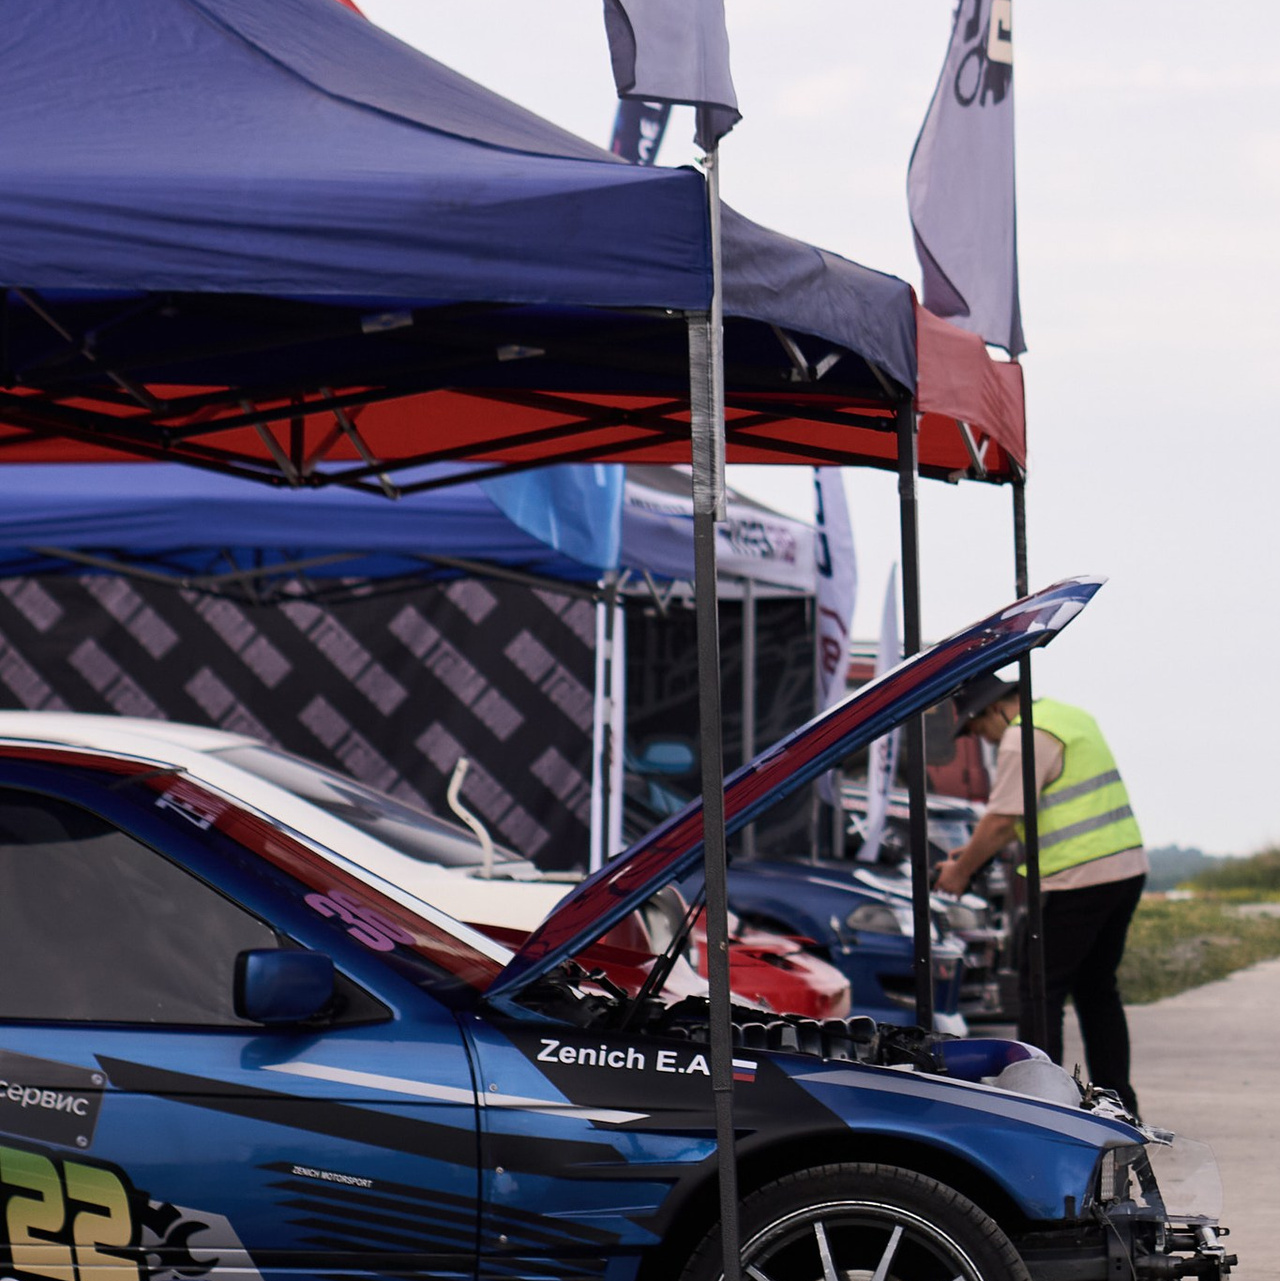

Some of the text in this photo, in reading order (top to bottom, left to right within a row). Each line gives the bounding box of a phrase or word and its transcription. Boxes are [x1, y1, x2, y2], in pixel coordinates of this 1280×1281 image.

[537, 1038, 645, 1070] Zenich
[292, 1165, 373, 1188] ZENICH MOTORSPORT
